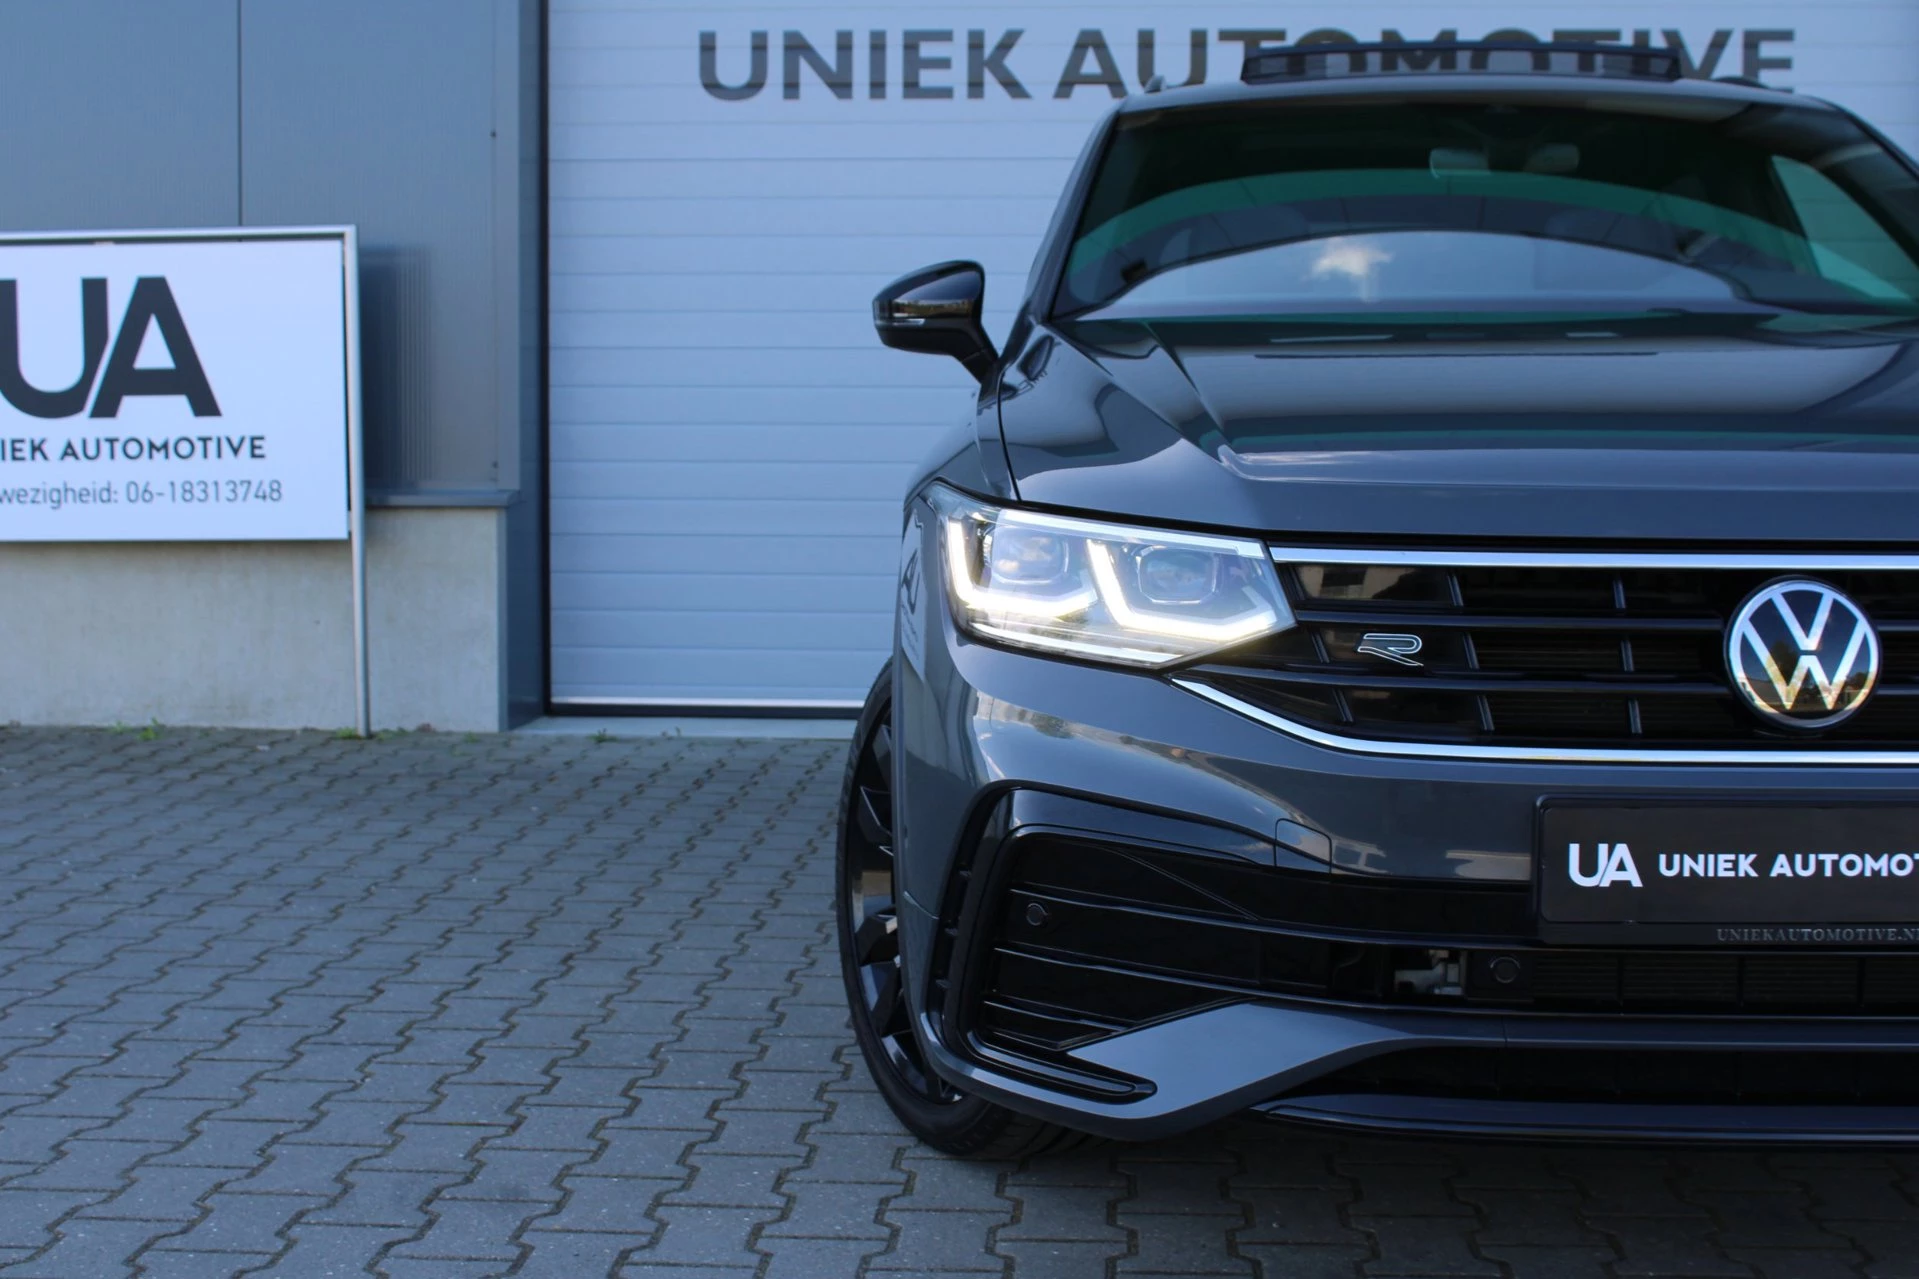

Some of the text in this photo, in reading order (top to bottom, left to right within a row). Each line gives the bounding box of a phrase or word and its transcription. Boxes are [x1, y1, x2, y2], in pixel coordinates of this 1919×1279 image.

[699, 28, 1796, 101] UNIEK AUTOMOTIVE
[0, 275, 222, 419] UA
[59, 436, 267, 461] AUTOMOTIVE
[125, 479, 283, 504] 06-18313748
[1568, 842, 1643, 887] UA
[1658, 853, 1759, 878] UNIEK
[1716, 927, 1919, 942] UNIEKAUTOMOTIVE.N
